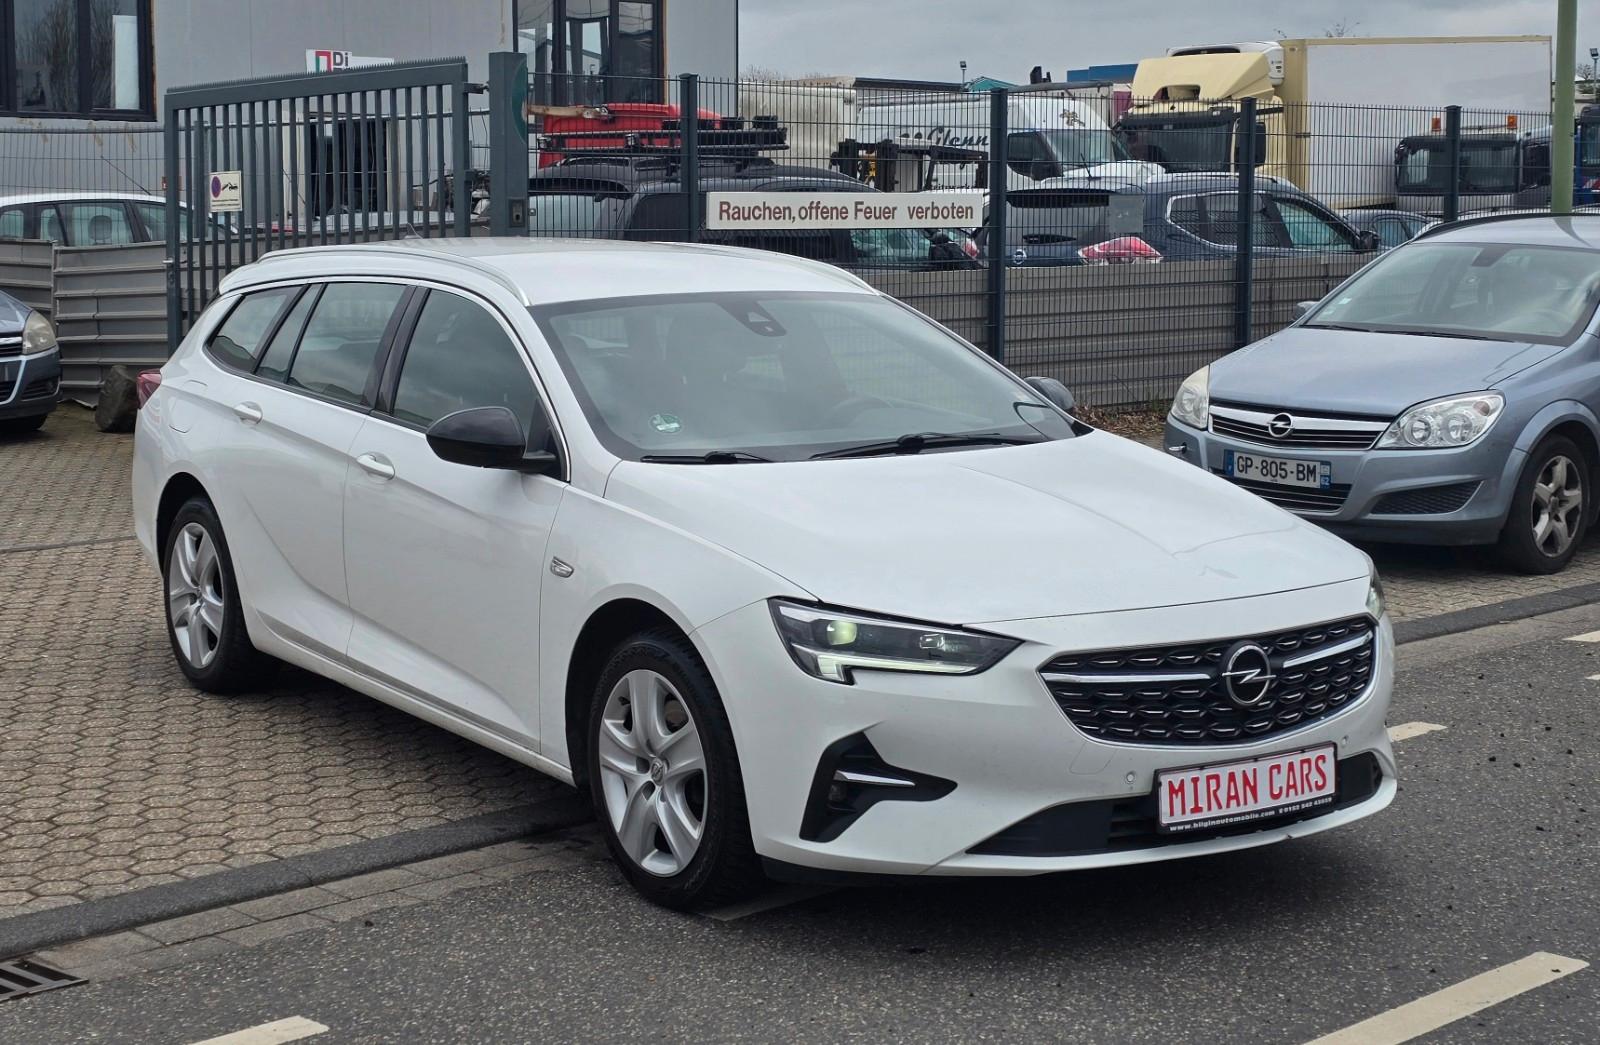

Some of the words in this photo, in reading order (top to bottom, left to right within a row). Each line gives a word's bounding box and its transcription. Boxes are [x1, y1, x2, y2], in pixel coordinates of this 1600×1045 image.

[333, 51, 349, 67] Di
[799, 201, 849, 221] offene
[854, 201, 897, 220] Feuer
[908, 204, 974, 221] verboten
[1237, 455, 1317, 482] GP-805-BM
[1168, 768, 1259, 817] MIRAN
[1269, 755, 1328, 800] CARS
